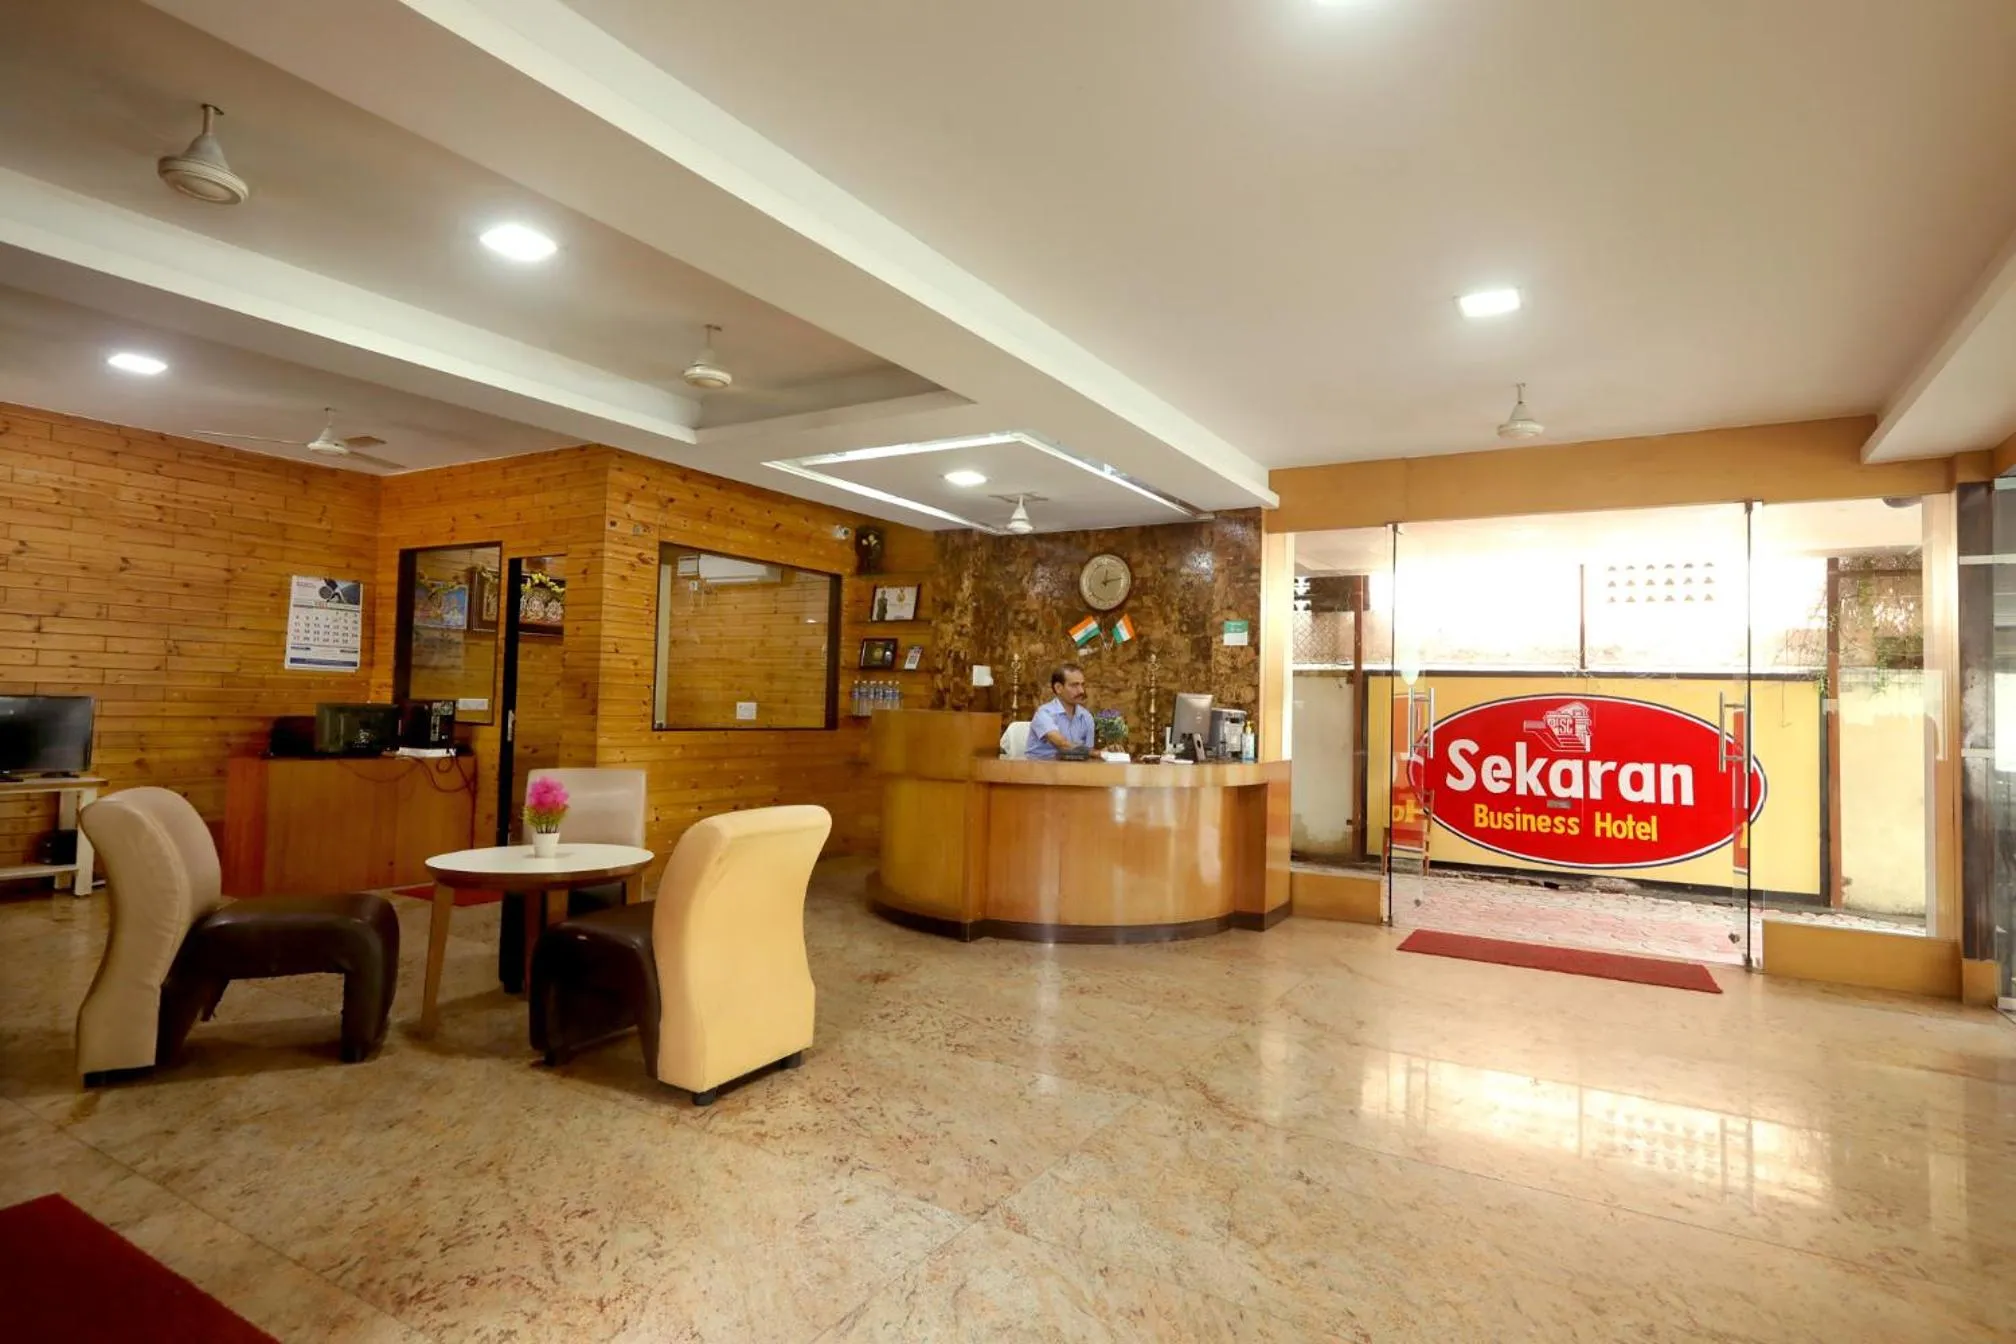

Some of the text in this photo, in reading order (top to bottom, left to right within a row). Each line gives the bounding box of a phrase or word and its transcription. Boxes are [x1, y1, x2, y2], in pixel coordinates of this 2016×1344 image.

[1445, 738, 1695, 806] Sekaran
[1474, 803, 1658, 842] Business Hotel
